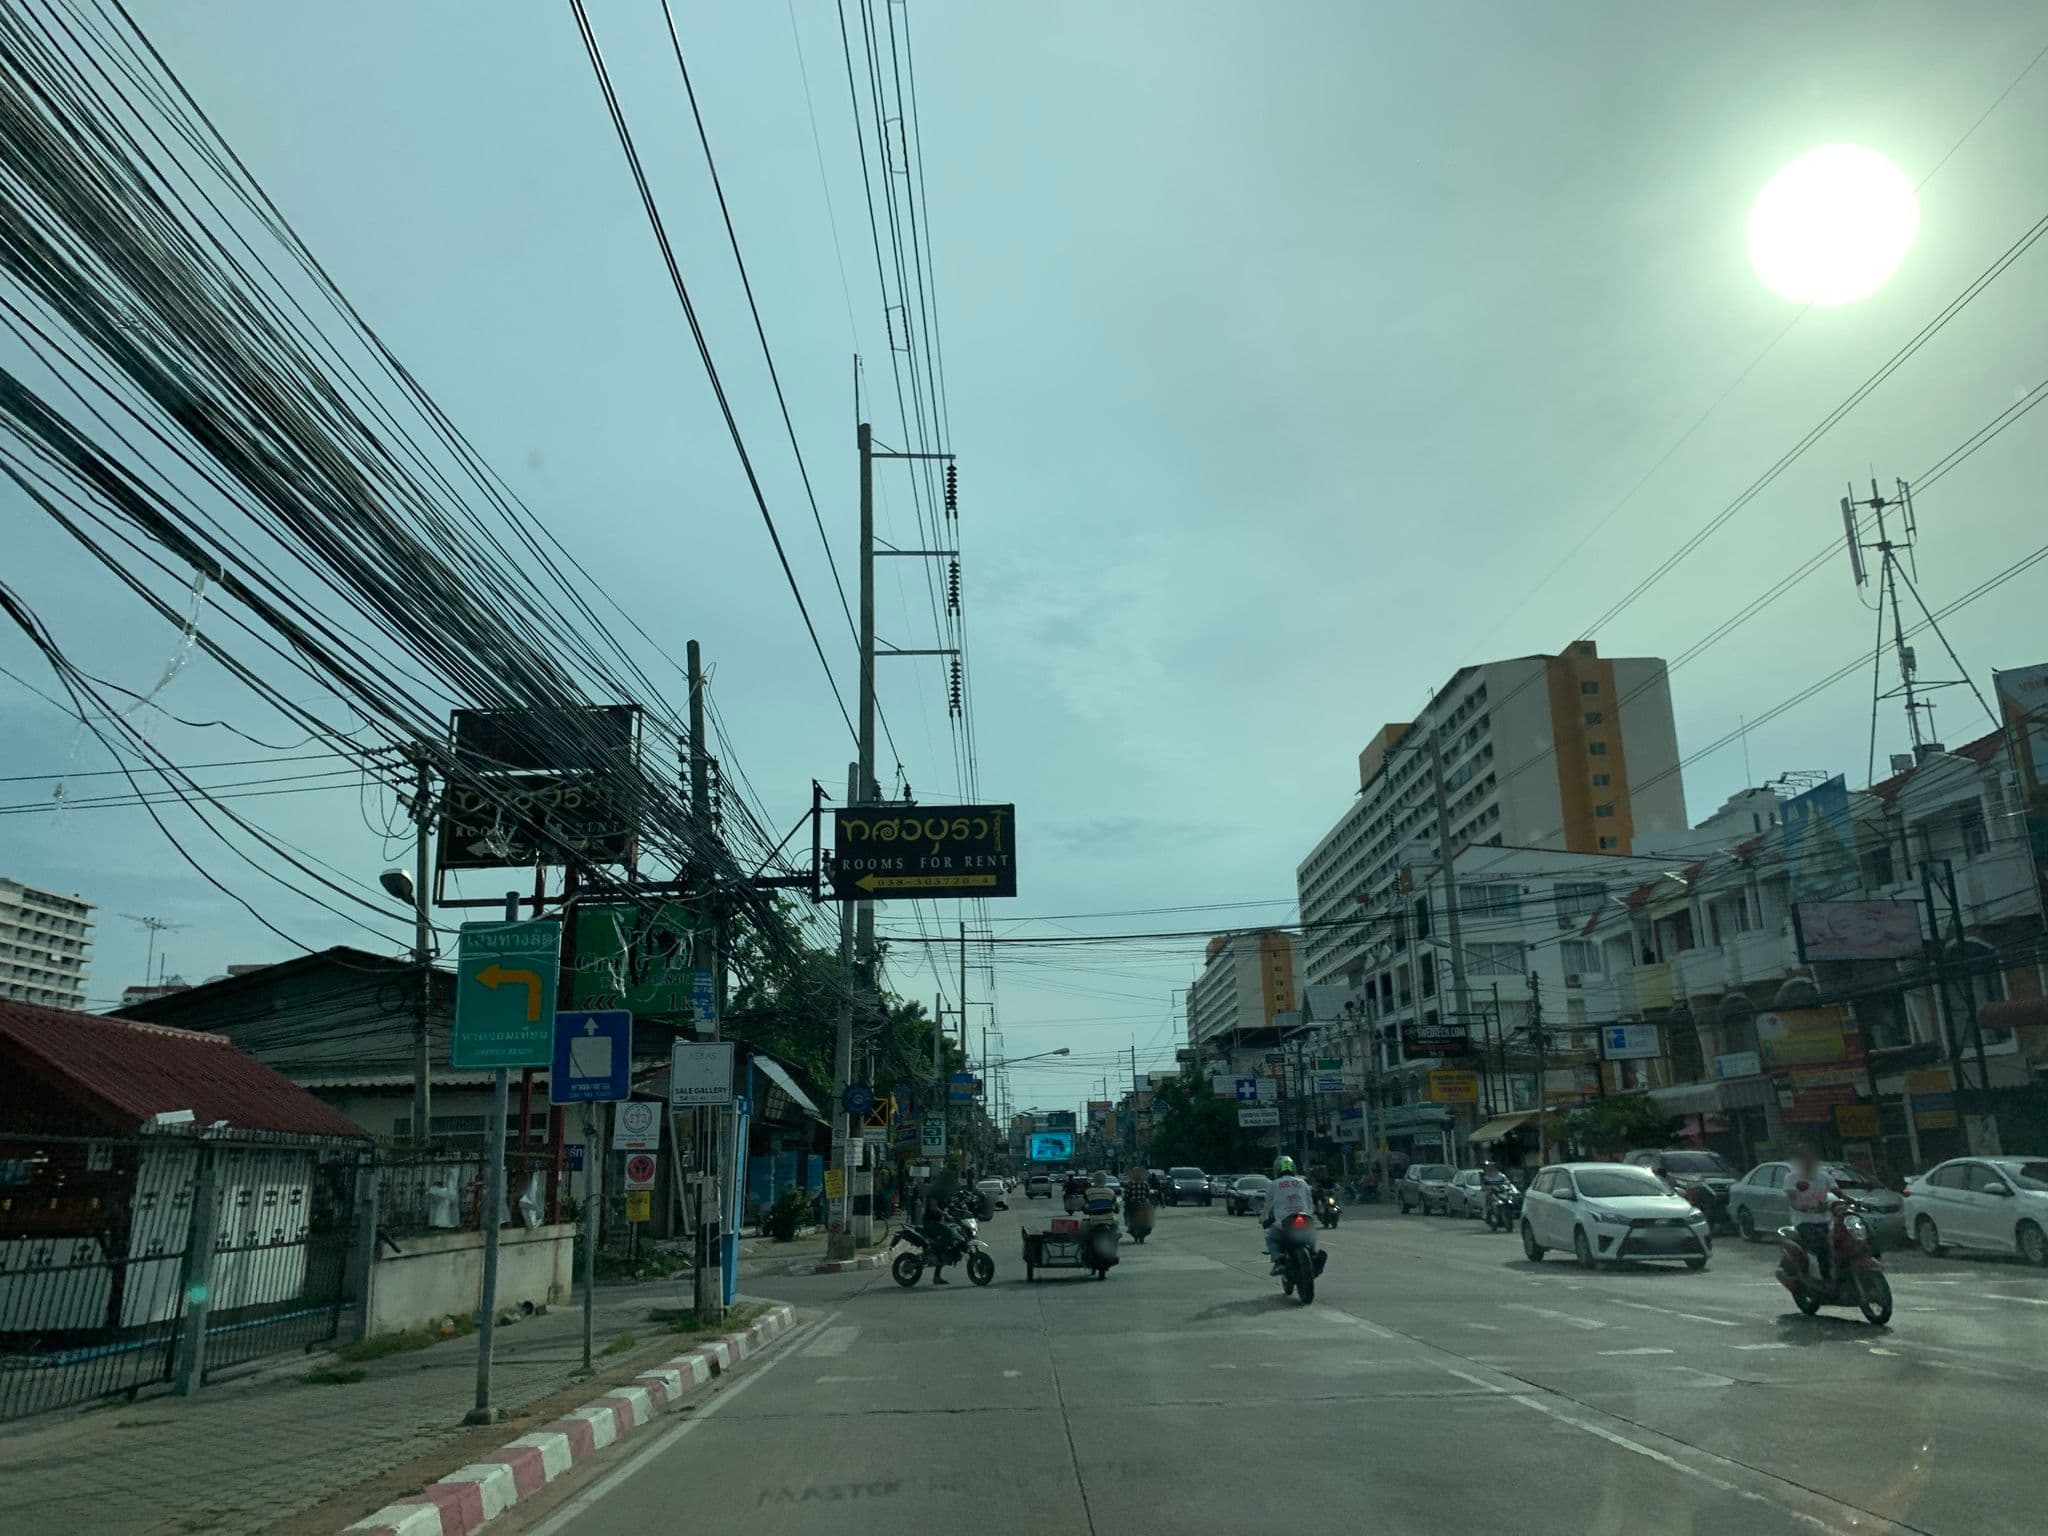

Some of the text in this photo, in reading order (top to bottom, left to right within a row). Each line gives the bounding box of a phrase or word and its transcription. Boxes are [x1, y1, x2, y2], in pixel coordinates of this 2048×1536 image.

[842, 854, 1009, 871] ROOMS FOR RENT
[675, 1086, 727, 1095] SALE GALLERY
